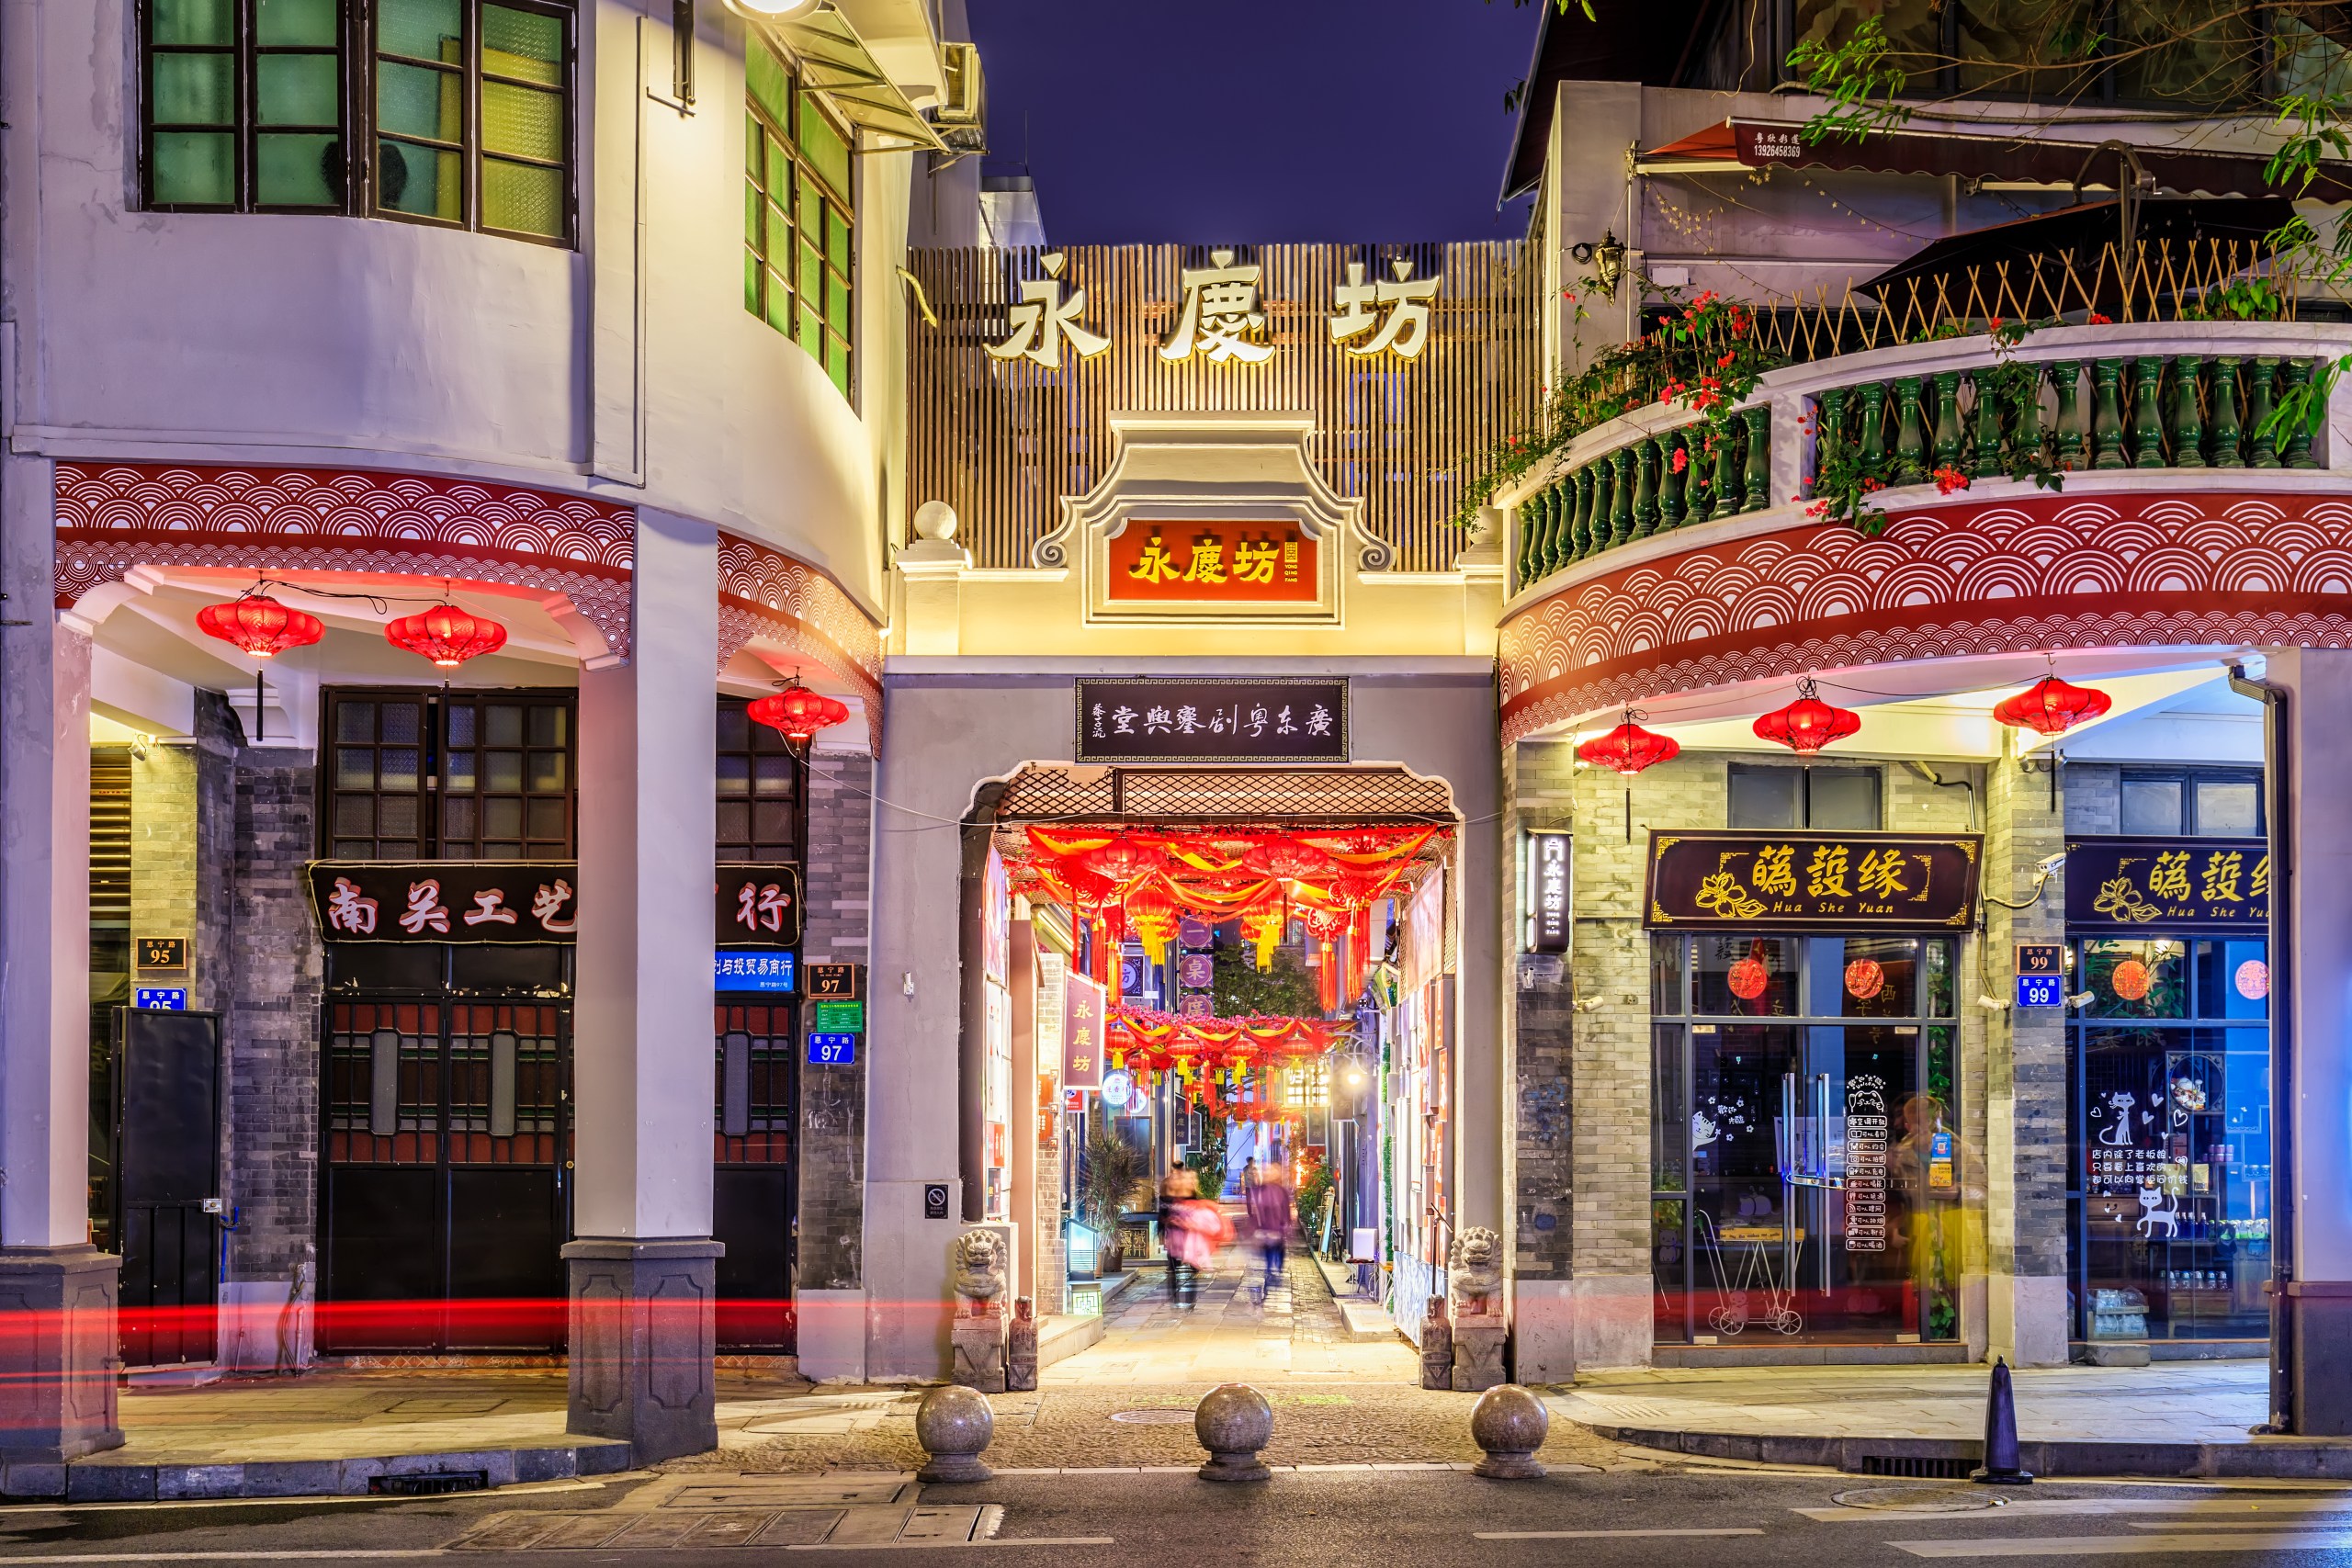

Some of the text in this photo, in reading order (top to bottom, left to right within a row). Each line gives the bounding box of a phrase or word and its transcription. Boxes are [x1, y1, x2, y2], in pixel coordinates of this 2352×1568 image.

[1754, 145, 1801, 158] 13926458369
[1773, 900, 1894, 914] Hua She Yuan
[2167, 906, 2269, 918] Hua She Yu
[151, 950, 170, 964] 95
[2031, 957, 2048, 969] 99
[822, 979, 840, 992] 97
[2022, 978, 2055, 987] 恩宁路
[142, 991, 180, 999] 恩宁路
[2030, 987, 2049, 1003] 99
[815, 1036, 849, 1044] 恩宁路
[821, 1045, 842, 1061] 97
